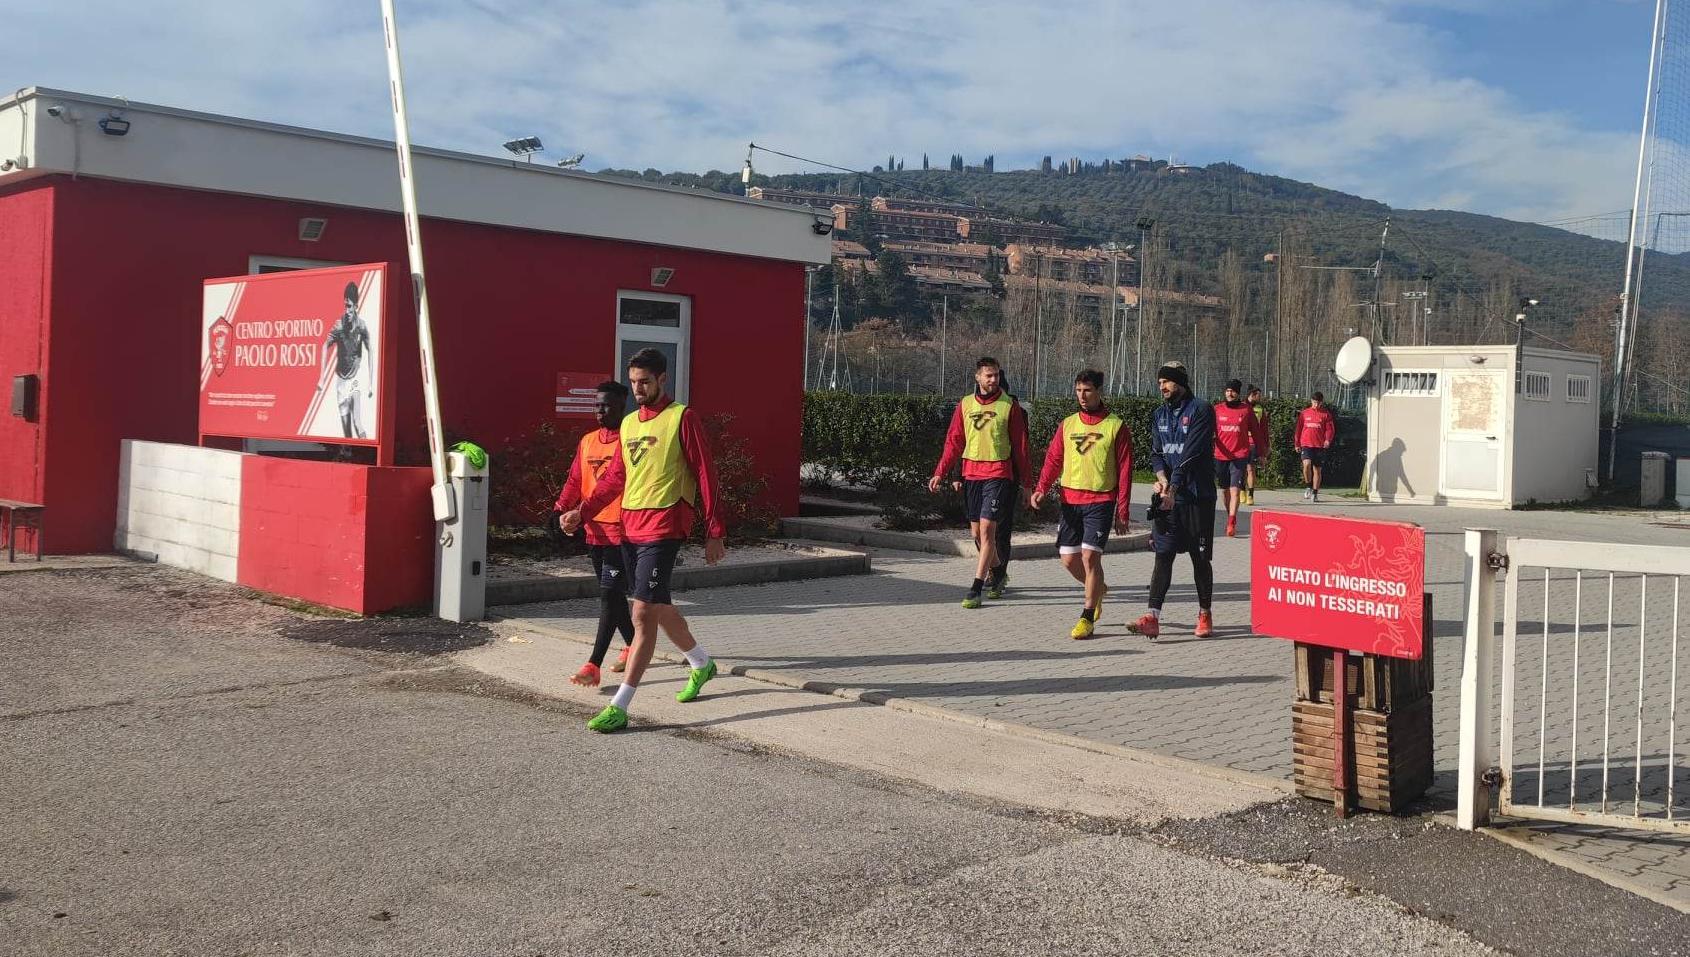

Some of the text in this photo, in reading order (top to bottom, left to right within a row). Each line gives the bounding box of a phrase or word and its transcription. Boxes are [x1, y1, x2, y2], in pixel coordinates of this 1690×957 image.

[235, 321, 272, 340] CENTRO
[274, 318, 324, 339] SPORTIVO
[235, 343, 317, 367] PAOLO ROSSI
[1268, 565, 1407, 598] VIETATO L'INGRESSO
[1268, 587, 1400, 620] AI NON TESSERATI
